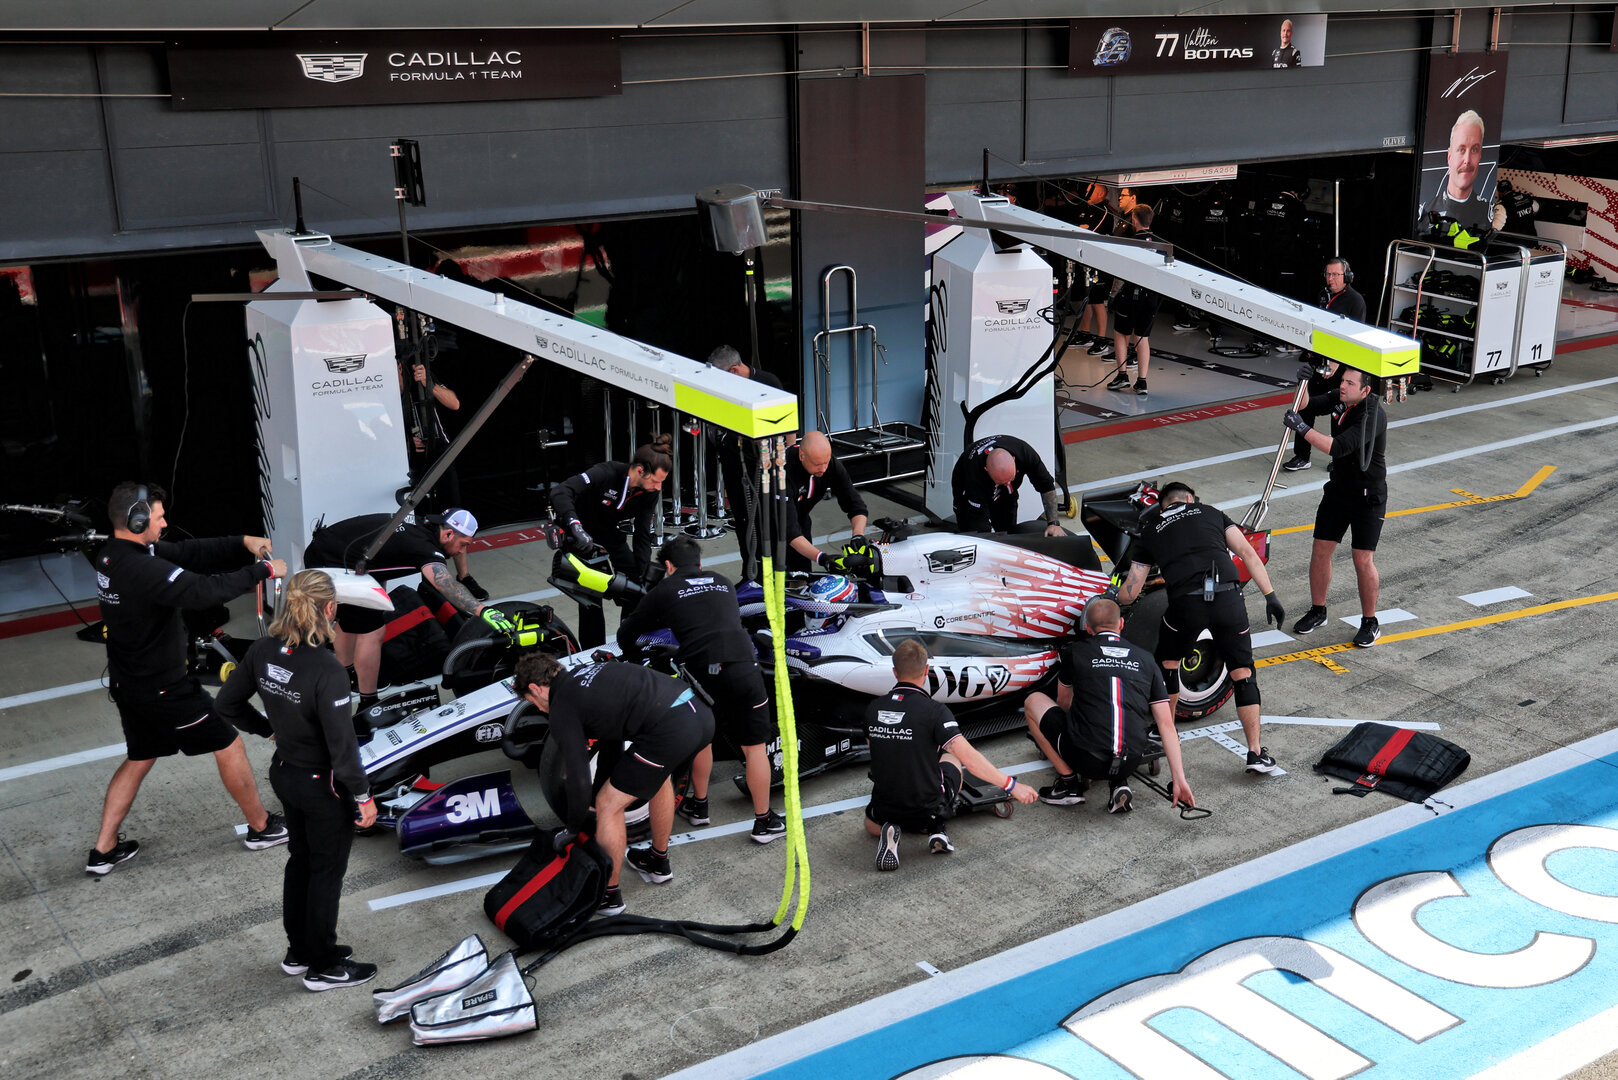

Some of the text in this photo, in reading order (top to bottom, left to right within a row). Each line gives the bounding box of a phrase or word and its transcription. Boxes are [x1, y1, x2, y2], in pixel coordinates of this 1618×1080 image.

[1154, 33, 1180, 57] 77
[1183, 27, 1220, 50] Valtteri
[388, 51, 522, 67] CADILLAC
[1184, 47, 1254, 60] BOTTAS
[390, 72, 465, 82] FORMULA
[478, 70, 522, 80] TEAM
[1383, 136, 1406, 147] OLIVER
[1122, 173, 1132, 182] 77
[1204, 294, 1253, 319] CADILLAC
[1256, 313, 1285, 329] FORMULA
[984, 316, 1041, 327] CADILLAC
[1486, 350, 1503, 368] 77
[1531, 343, 1543, 361] 11
[552, 342, 606, 371] CADILLAC
[610, 365, 643, 383] FORMULA
[312, 374, 383, 390] CADILLAC
[312, 387, 353, 397] FORMULA
[362, 383, 384, 392] TEAM
[1153, 401, 1260, 424] PIT-LANE
[677, 584, 728, 595] CADILLAC
[945, 610, 996, 624] CORE SCIENTIFIC
[1091, 658, 1140, 668] CADILLAC
[259, 677, 302, 699] CADILLAC
[926, 665, 986, 698] WG
[382, 694, 438, 712] CORE SCIENTIFIC
[477, 727, 503, 742] FIA
[868, 725, 913, 735] CADILLAC
[445, 787, 502, 824] 3M
[891, 824, 1618, 1080] mco
[464, 990, 495, 1008] SPARE
